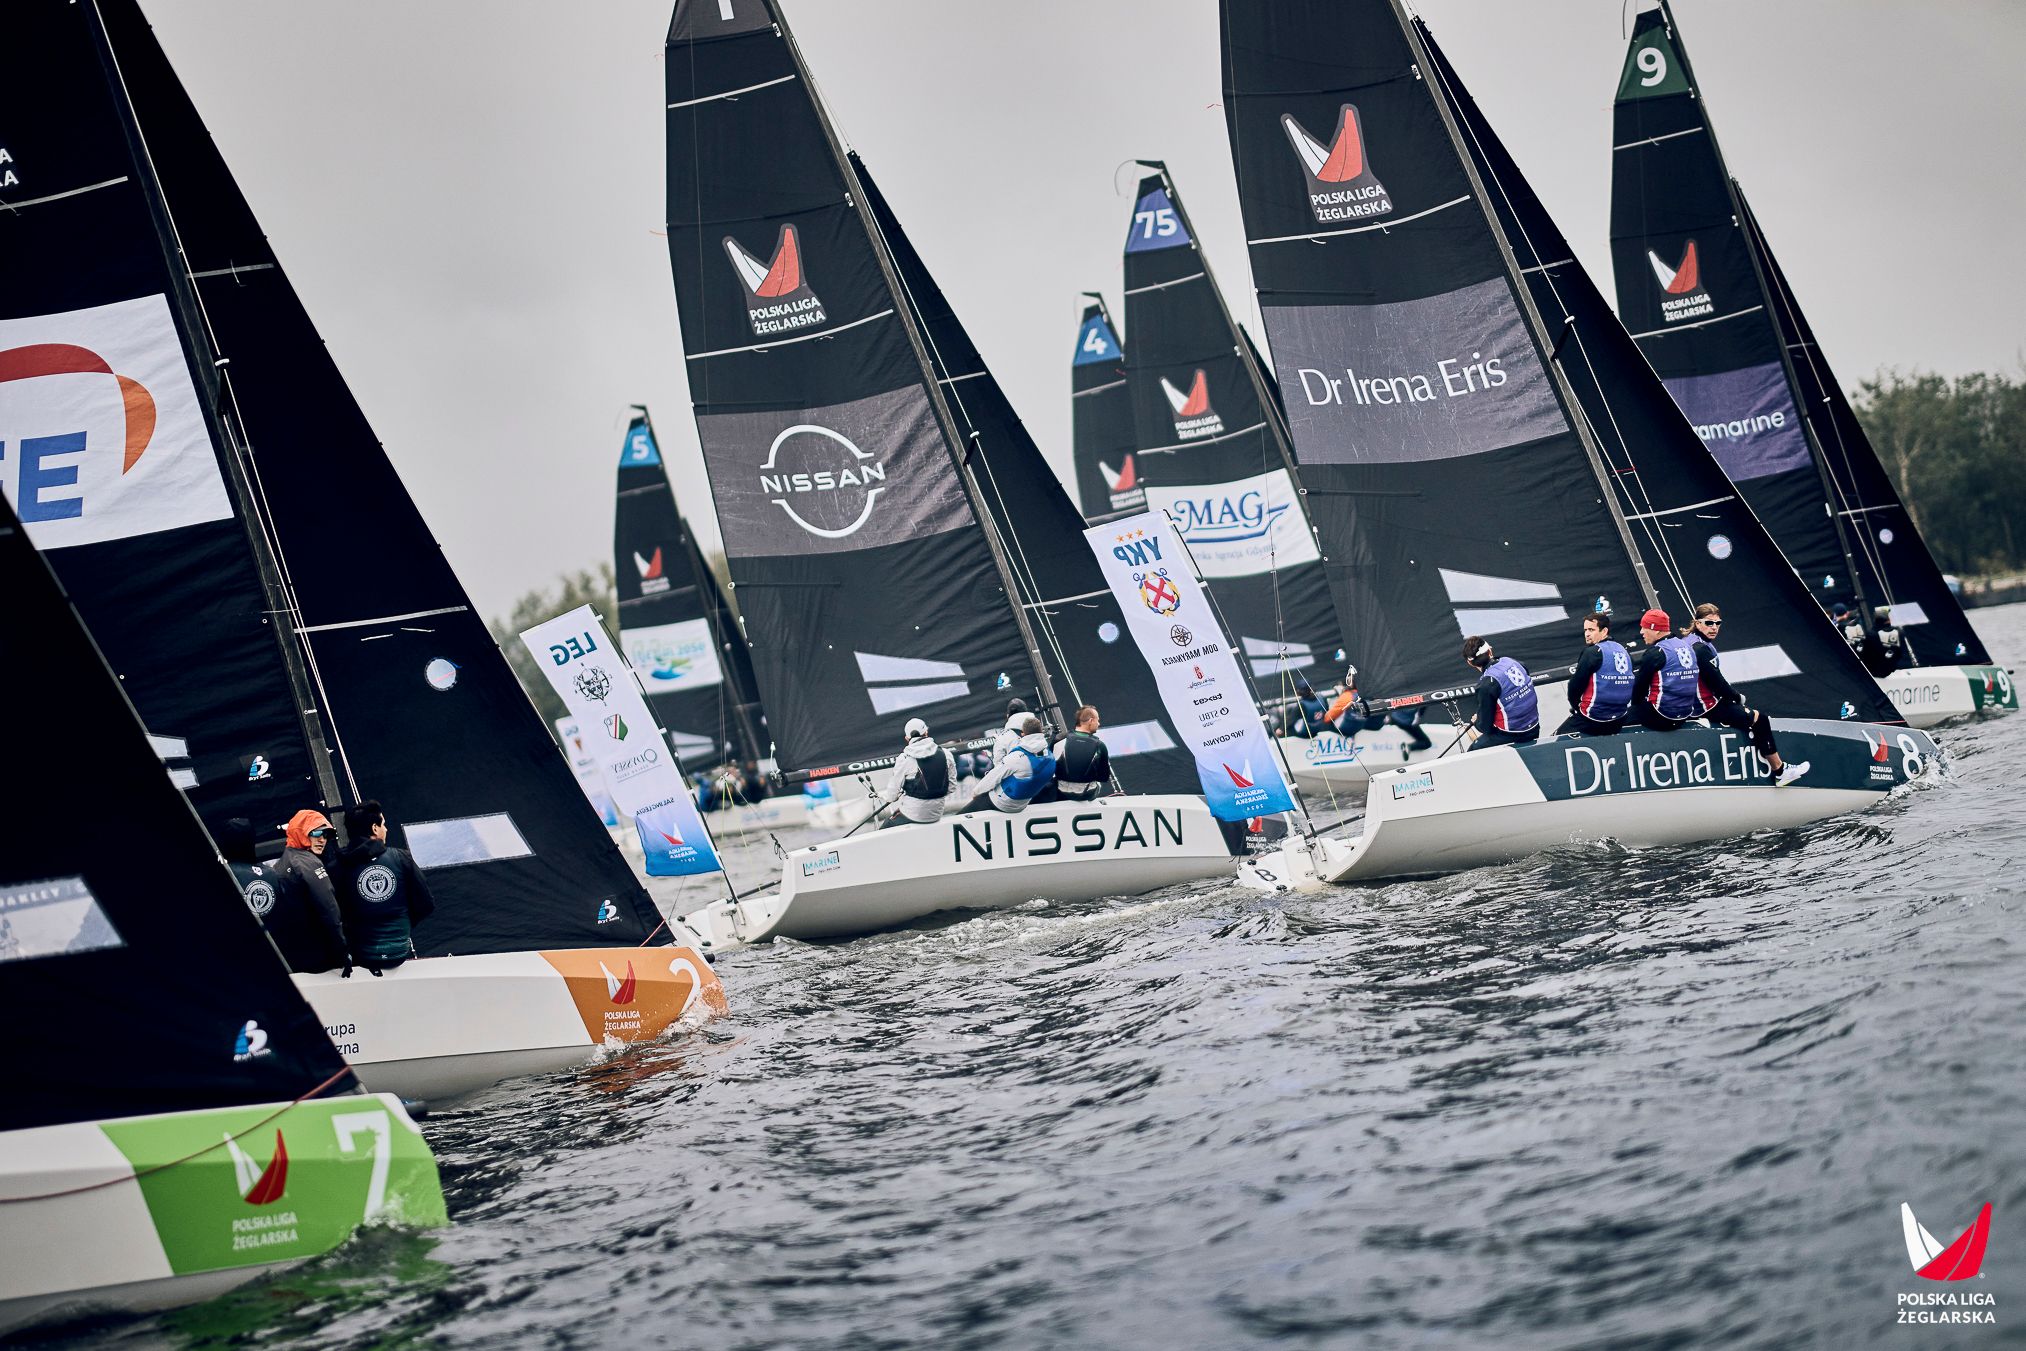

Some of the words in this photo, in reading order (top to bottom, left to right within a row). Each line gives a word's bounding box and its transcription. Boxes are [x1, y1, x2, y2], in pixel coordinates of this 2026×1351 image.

[1637, 47, 1667, 87] 9
[1311, 190, 1356, 206] POLSKA
[1355, 184, 1386, 200] LIGA
[1316, 199, 1392, 221] ŻEGLARSKA
[1135, 208, 1178, 239] 75
[749, 303, 793, 321] POLSKA
[792, 296, 821, 313] LIGA
[1661, 298, 1691, 311] POLSKA
[754, 310, 827, 335] ŻEGLARSKA
[1083, 327, 1107, 355] 4
[1298, 368, 1343, 406] Dr
[1346, 368, 1437, 405] Irena
[1437, 351, 1508, 397] Eris
[632, 435, 649, 461] 5
[760, 461, 886, 494] NISSAN
[1172, 490, 1265, 534] MAG
[1997, 670, 2011, 704] 9
[1391, 695, 1424, 708] HARKEN
[1305, 736, 1357, 760] MAG
[1896, 733, 1924, 779] 8
[809, 766, 840, 778] HARKEN
[863, 757, 896, 769] OAKLE
[1565, 746, 1616, 796] Dr
[1624, 742, 1715, 789] Irena
[1395, 777, 1431, 792] MARINE
[952, 808, 1184, 863] NISSAN
[805, 855, 838, 870] MARINE
[668, 957, 702, 1014] 2
[604, 1011, 626, 1020] POLSKA
[627, 1010, 641, 1019] LIGA
[604, 1020, 641, 1030] ŻEGLARSKA
[331, 1109, 391, 1224] 7
[232, 1217, 273, 1233] POLSKA
[273, 1211, 298, 1227] LIGA
[232, 1228, 299, 1251] ŻEGLARSKA
